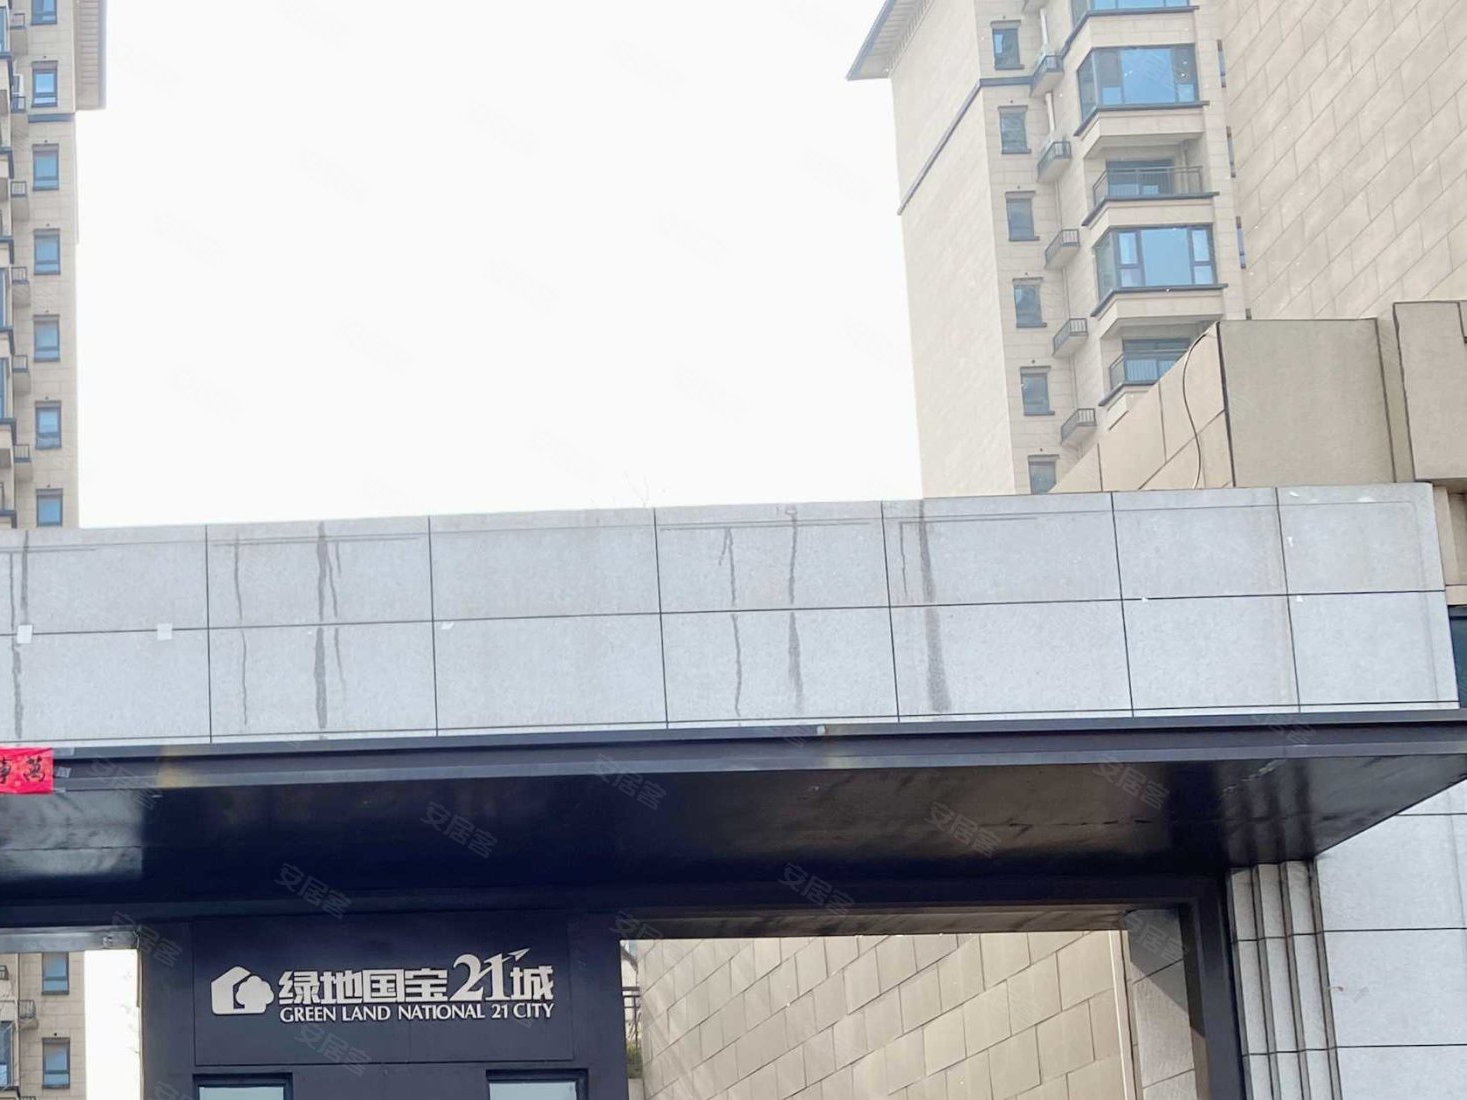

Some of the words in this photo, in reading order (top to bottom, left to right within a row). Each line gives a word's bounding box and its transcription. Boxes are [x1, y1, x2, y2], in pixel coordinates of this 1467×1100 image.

[278, 952, 554, 1005] 绿地国宝21城
[279, 1005, 337, 1023] GREEN
[342, 1005, 391, 1022] LAND
[398, 1003, 486, 1021] NATIONAL
[491, 1003, 509, 1019] 21
[513, 1002, 555, 1019] CITY
